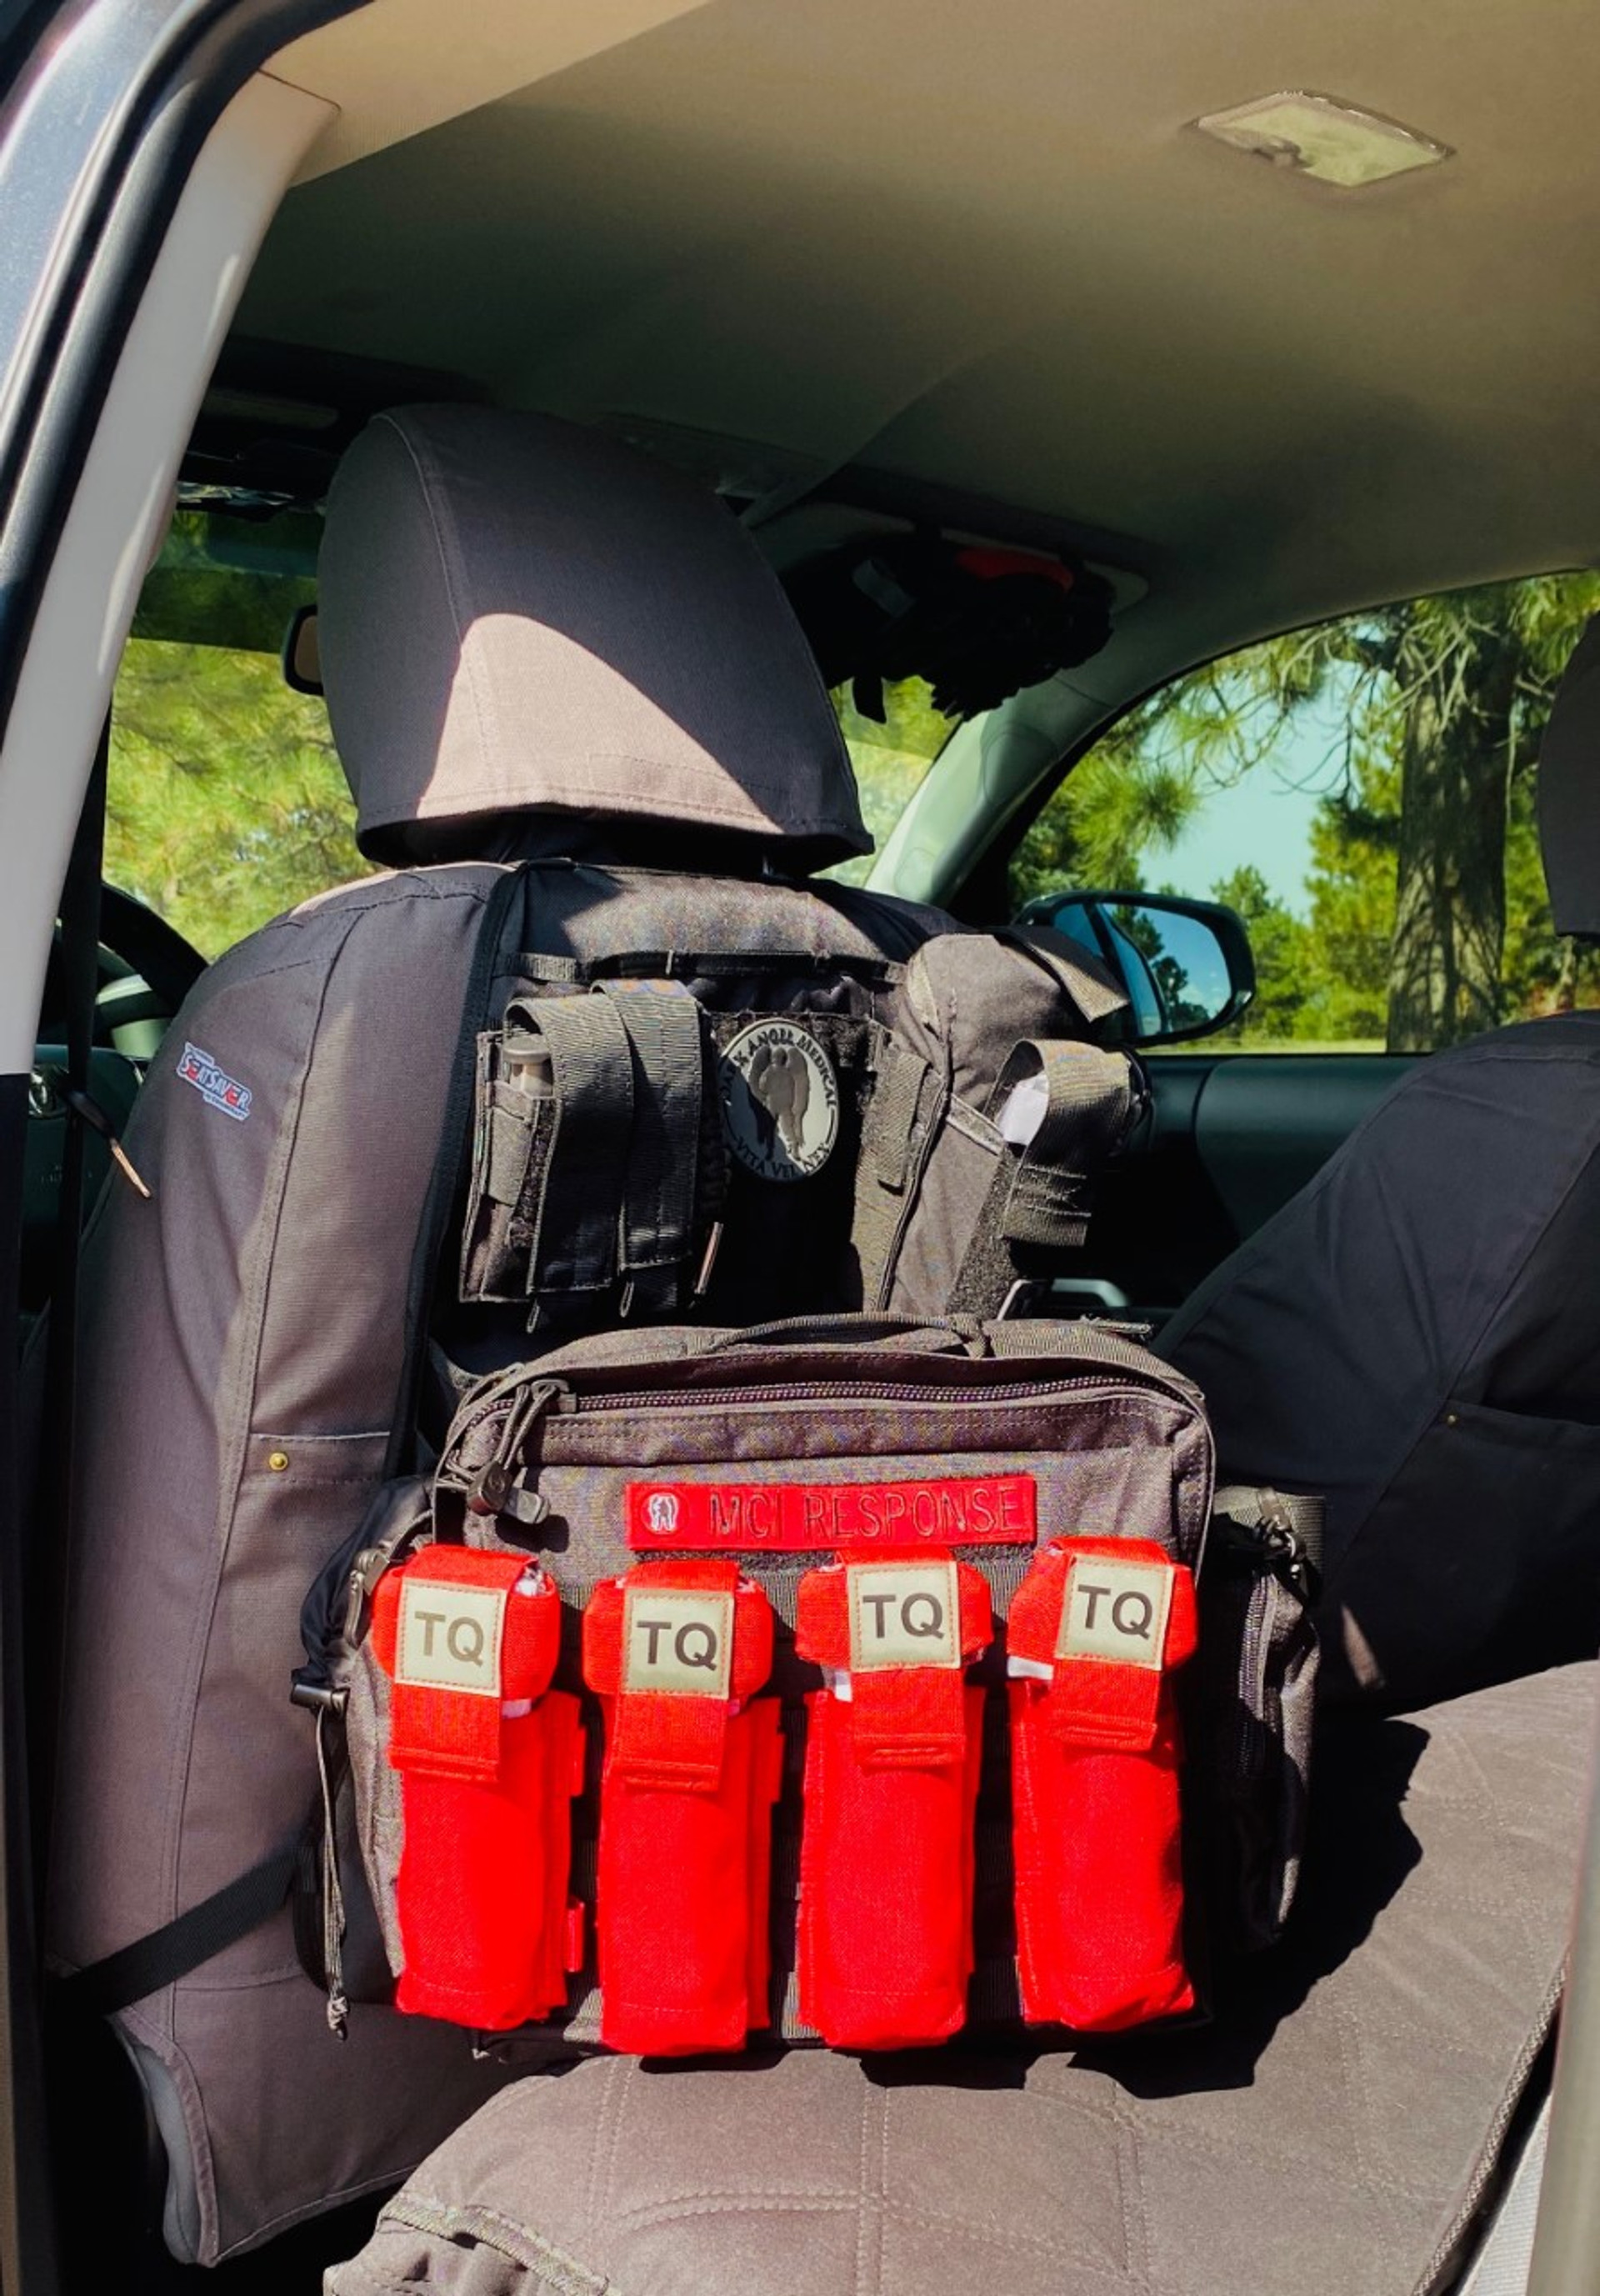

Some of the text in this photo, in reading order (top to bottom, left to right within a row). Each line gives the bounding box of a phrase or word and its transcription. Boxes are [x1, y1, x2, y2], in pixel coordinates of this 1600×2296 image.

[720, 1028, 837, 1108] DARK ANGEL MEDICAL
[736, 1136, 765, 1174] VITA
[709, 1484, 1022, 1538] MCI RESPONSE
[415, 1611, 484, 1667] TQ
[862, 1593, 944, 1639] TQ
[1078, 1584, 1152, 1640] TQ
[637, 1620, 718, 1671] TQ
